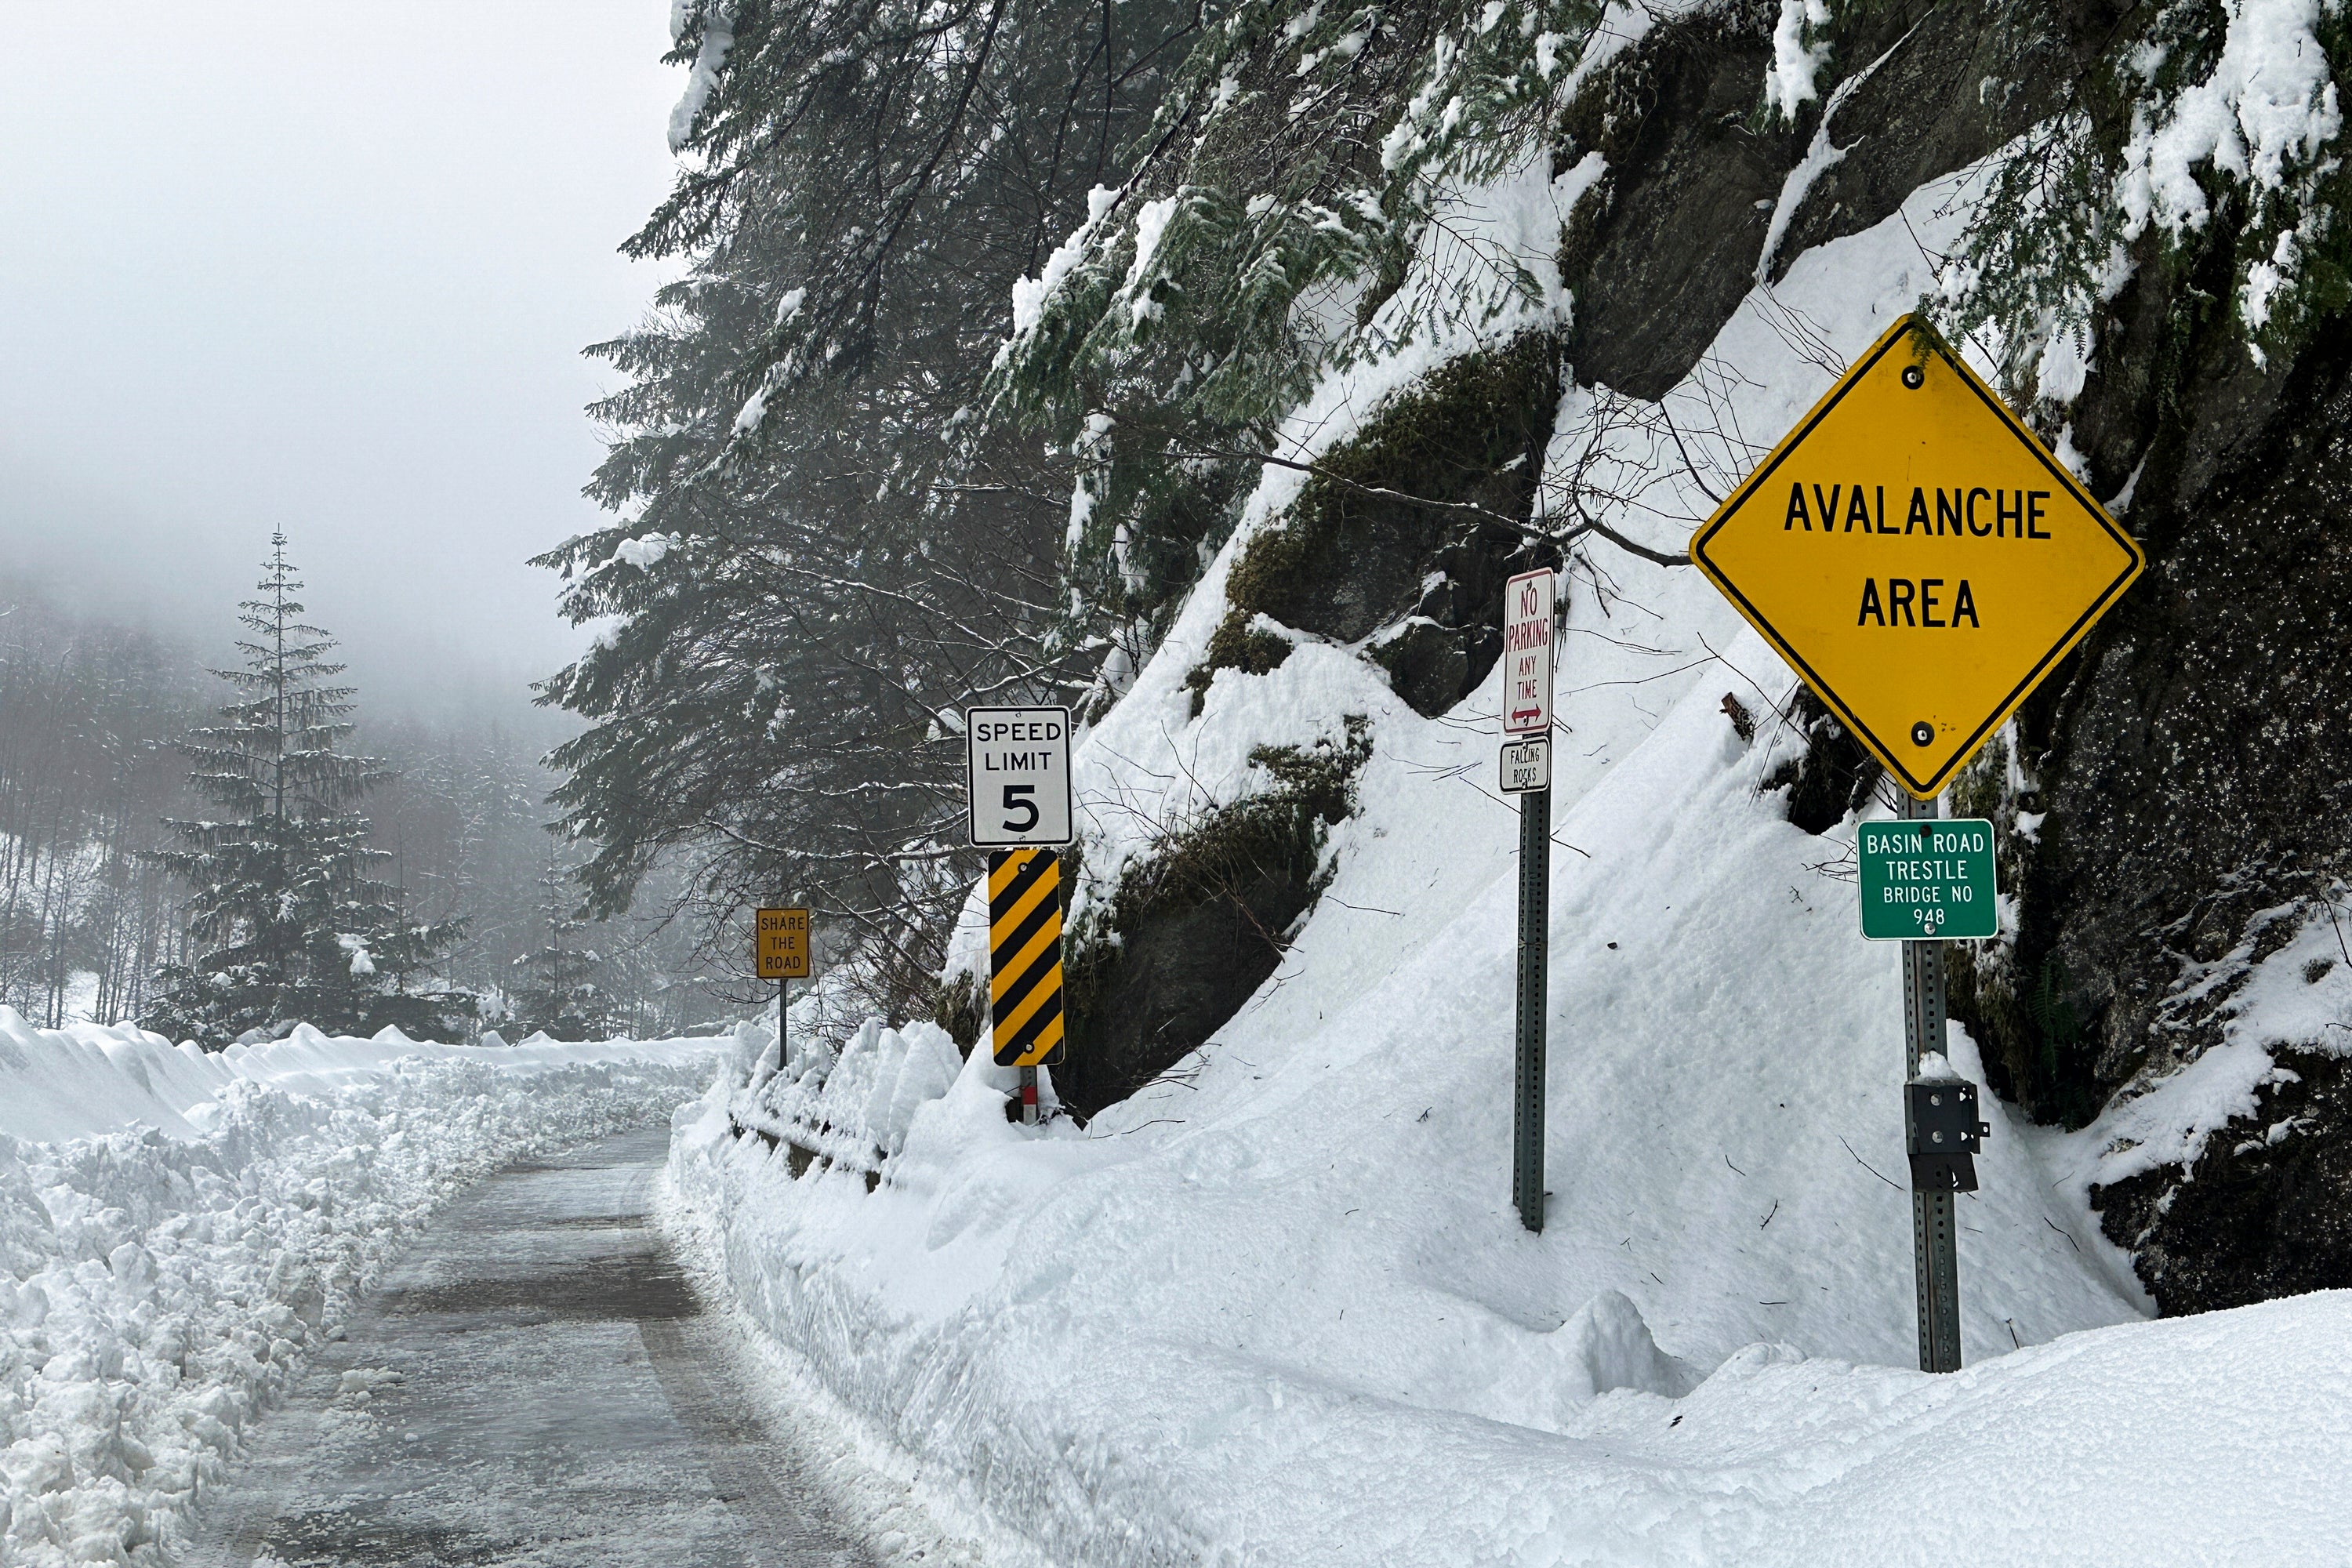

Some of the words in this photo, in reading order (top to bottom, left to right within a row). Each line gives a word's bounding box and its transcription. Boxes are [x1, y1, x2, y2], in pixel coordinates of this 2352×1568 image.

[1784, 481, 2052, 539] AVALANCHE
[1520, 587, 1537, 619] NO
[1857, 577, 1980, 629] AREA
[1508, 617, 1548, 653] PARKING
[1519, 655, 1537, 677] ANY
[1517, 679, 1537, 701] TIME
[977, 722, 1062, 742] SPEED
[985, 751, 1052, 771] LIMIT
[1510, 747, 1540, 764] FALLING
[1002, 784, 1040, 833] 5
[1867, 833, 1922, 855] BASIN
[1933, 833, 1984, 854] ROAD
[1886, 859, 1969, 880] TRESTLE
[1883, 886, 1941, 903] BRIDGE
[1951, 885, 1973, 902] NO
[760, 916, 805, 931] SHARE
[1913, 908, 1945, 925] 948
[771, 936, 795, 950] THE
[765, 956, 800, 970] ROAD
